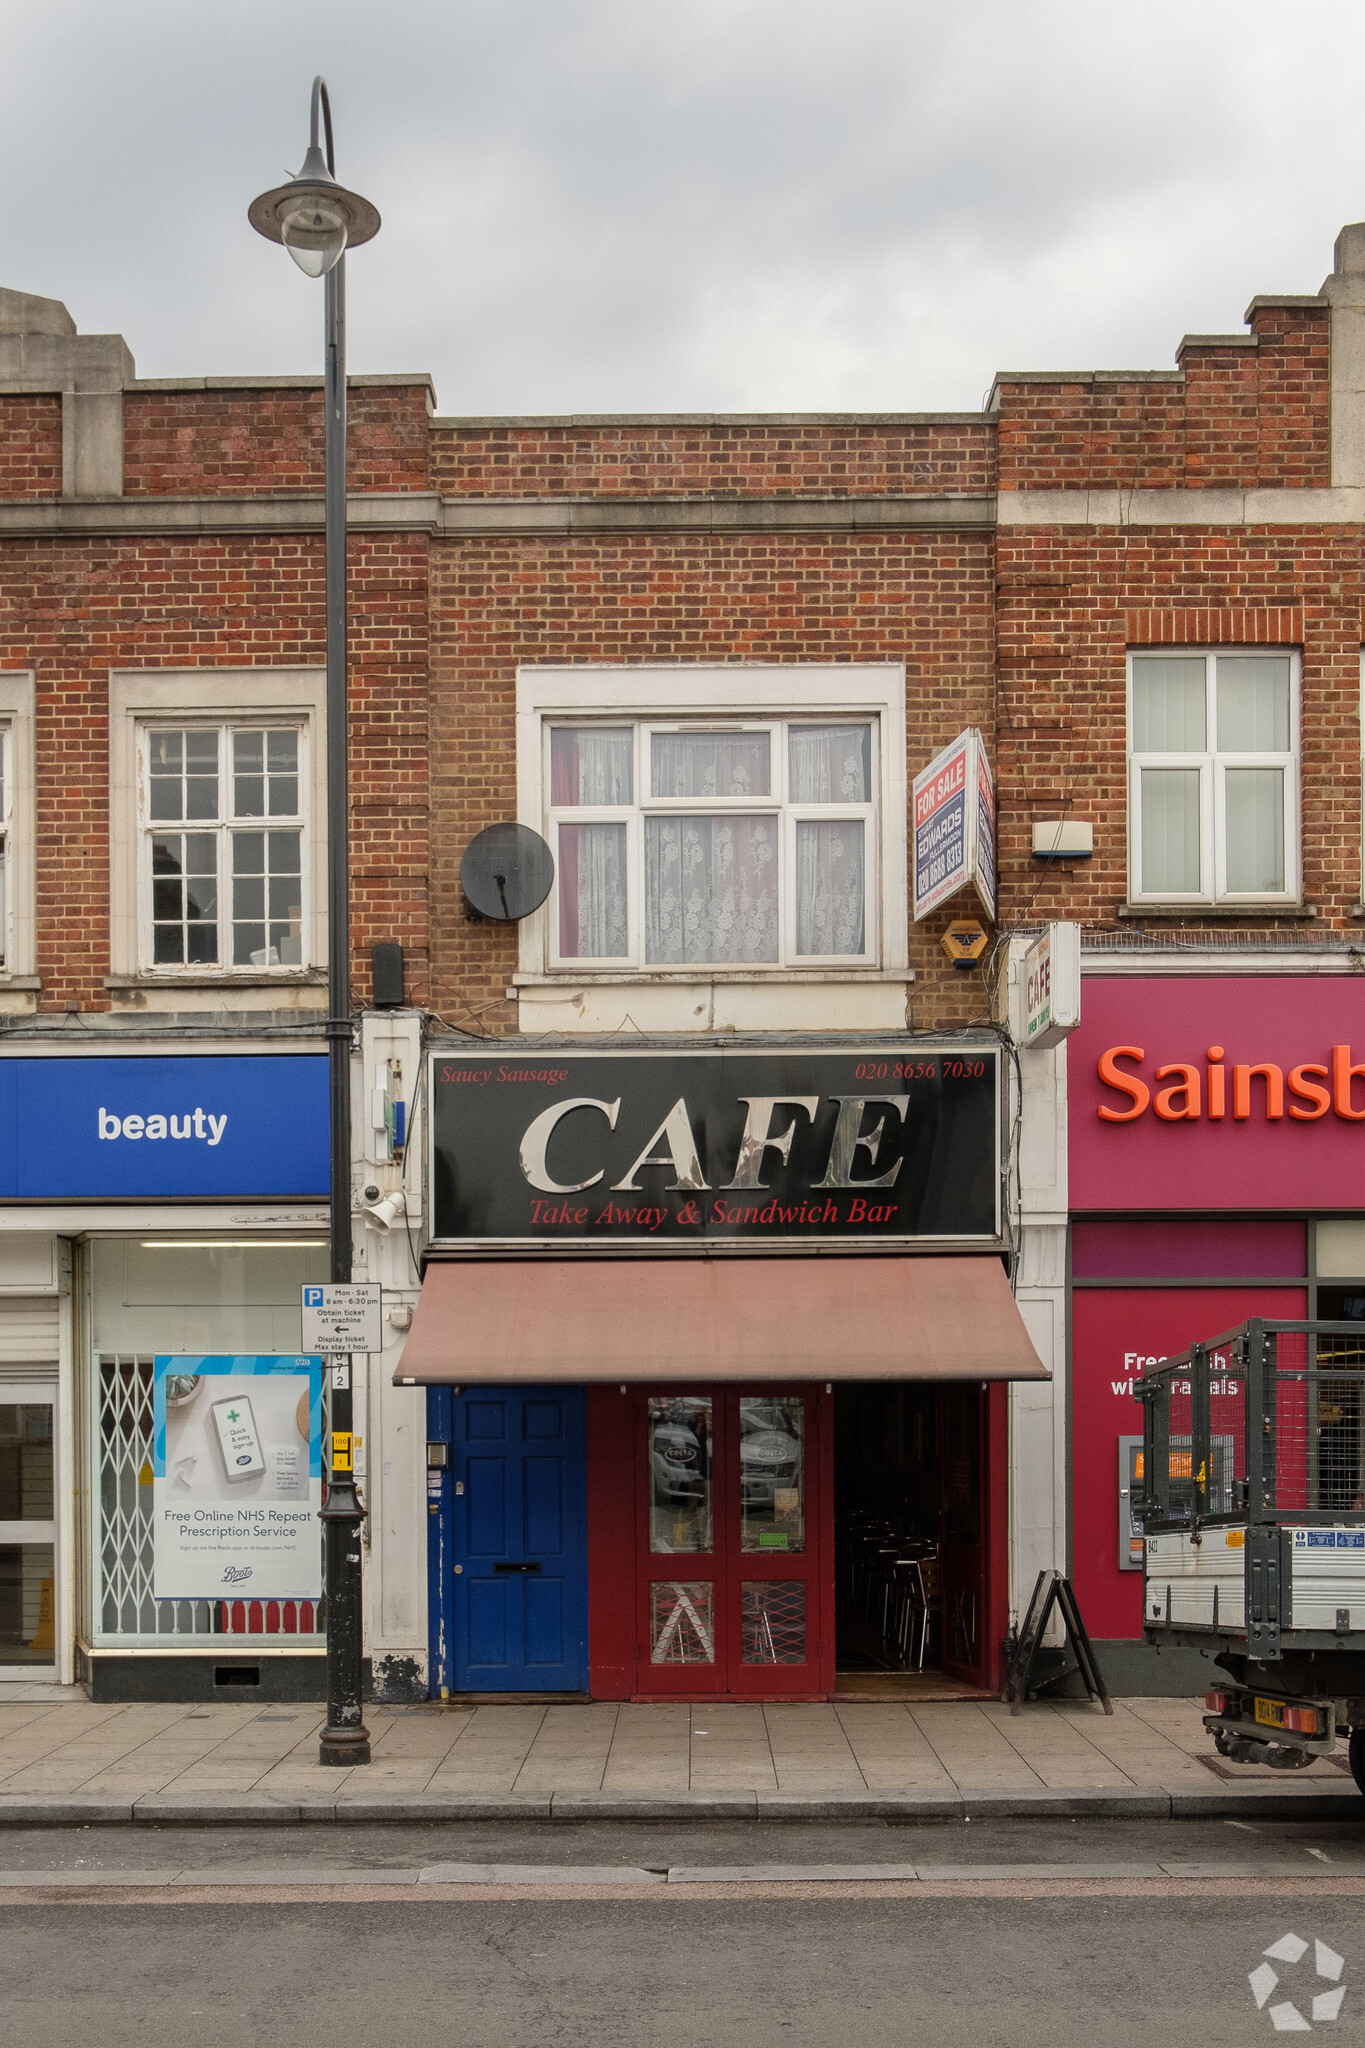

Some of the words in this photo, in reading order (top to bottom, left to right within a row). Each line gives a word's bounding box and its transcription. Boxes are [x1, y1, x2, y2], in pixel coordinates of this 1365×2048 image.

[917, 785, 935, 821] FOR
[937, 759, 964, 802] SALE
[917, 820, 934, 840] STUART
[918, 807, 962, 860] EDWARDS
[918, 870, 929, 896] 020
[946, 840, 962, 875] 8313
[1027, 956, 1050, 1014] CAFE
[440, 1065, 492, 1086] Saucy
[497, 1065, 569, 1086] Sausage
[855, 1063, 888, 1080] 020
[892, 1062, 936, 1080] 8656
[942, 1061, 985, 1078] 7030
[98, 1106, 228, 1146] beauty
[519, 1095, 910, 1194] CAFE
[529, 1200, 589, 1225] Take
[594, 1200, 668, 1231] Away
[676, 1200, 701, 1225] &
[710, 1198, 838, 1225] Sandwich
[846, 1199, 898, 1223] Bar
[309, 1289, 321, 1306] P
[229, 1427, 247, 1436] Quick
[233, 1441, 254, 1450] sign-up
[668, 1449, 692, 1457] COSTA
[760, 1449, 783, 1457] COSTA
[164, 1510, 191, 1521] Free
[194, 1509, 234, 1521] Online
[237, 1510, 265, 1521] NHS
[269, 1510, 311, 1524] Repeat
[179, 1525, 250, 1539] Prescription
[253, 1525, 297, 1537] Service
[221, 1566, 253, 1583] Boots
